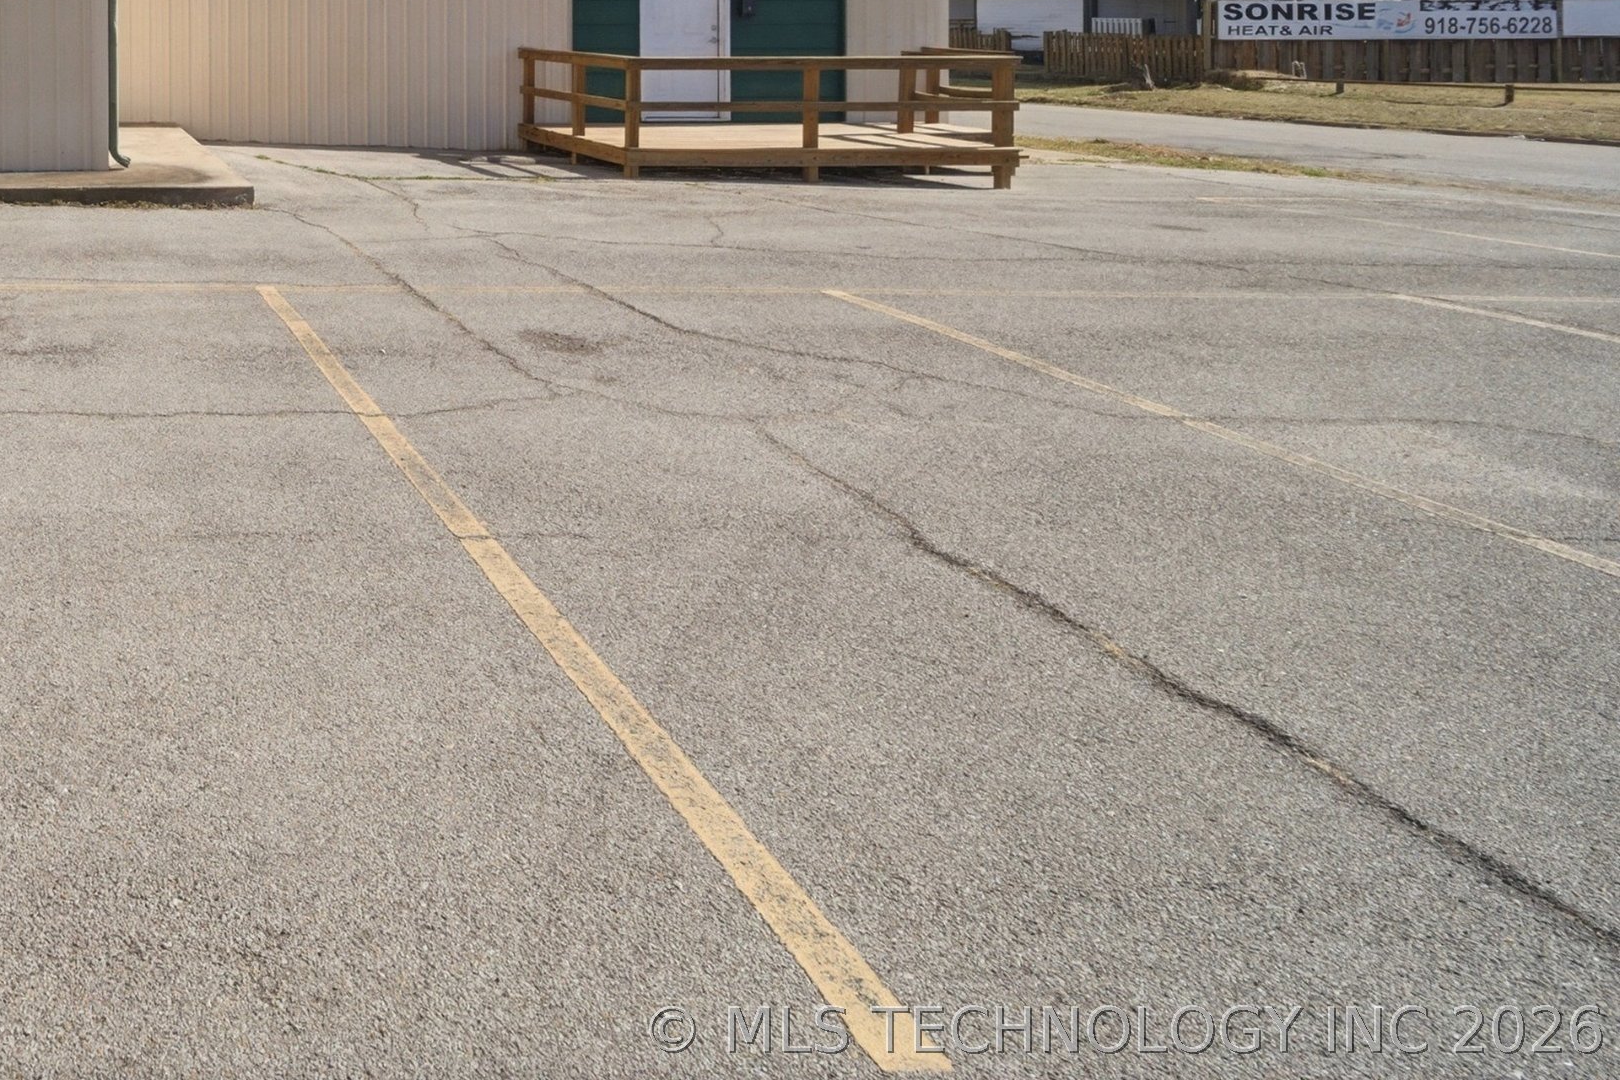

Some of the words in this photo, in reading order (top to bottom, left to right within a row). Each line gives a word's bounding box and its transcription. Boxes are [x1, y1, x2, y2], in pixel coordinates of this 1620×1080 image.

[1223, 2, 1376, 21] SONRISE
[1298, 25, 1333, 36] AIR
[1424, 16, 1553, 34] 918-756-6228
